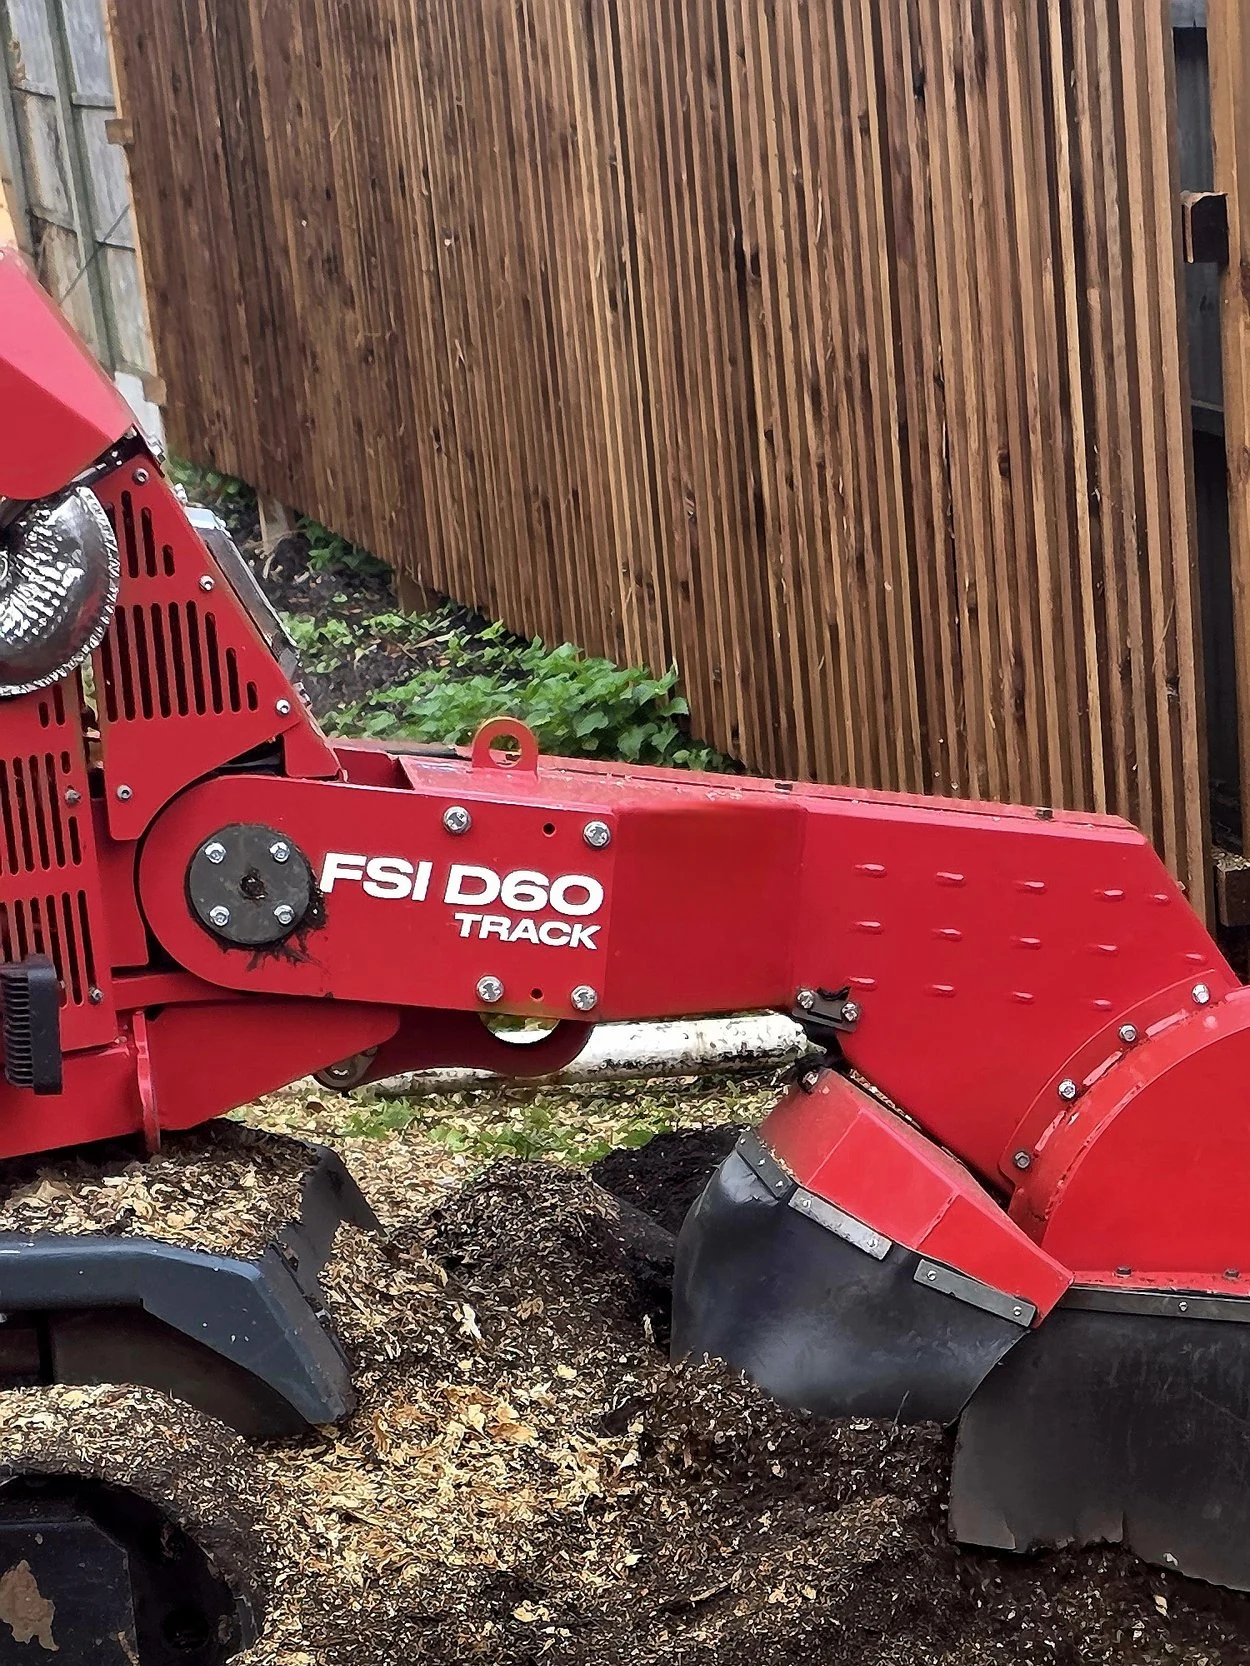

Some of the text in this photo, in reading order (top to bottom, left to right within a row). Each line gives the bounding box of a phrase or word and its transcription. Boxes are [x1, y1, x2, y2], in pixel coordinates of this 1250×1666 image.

[319, 852, 604, 916] FSI D60
[454, 912, 602, 950] TRACK
